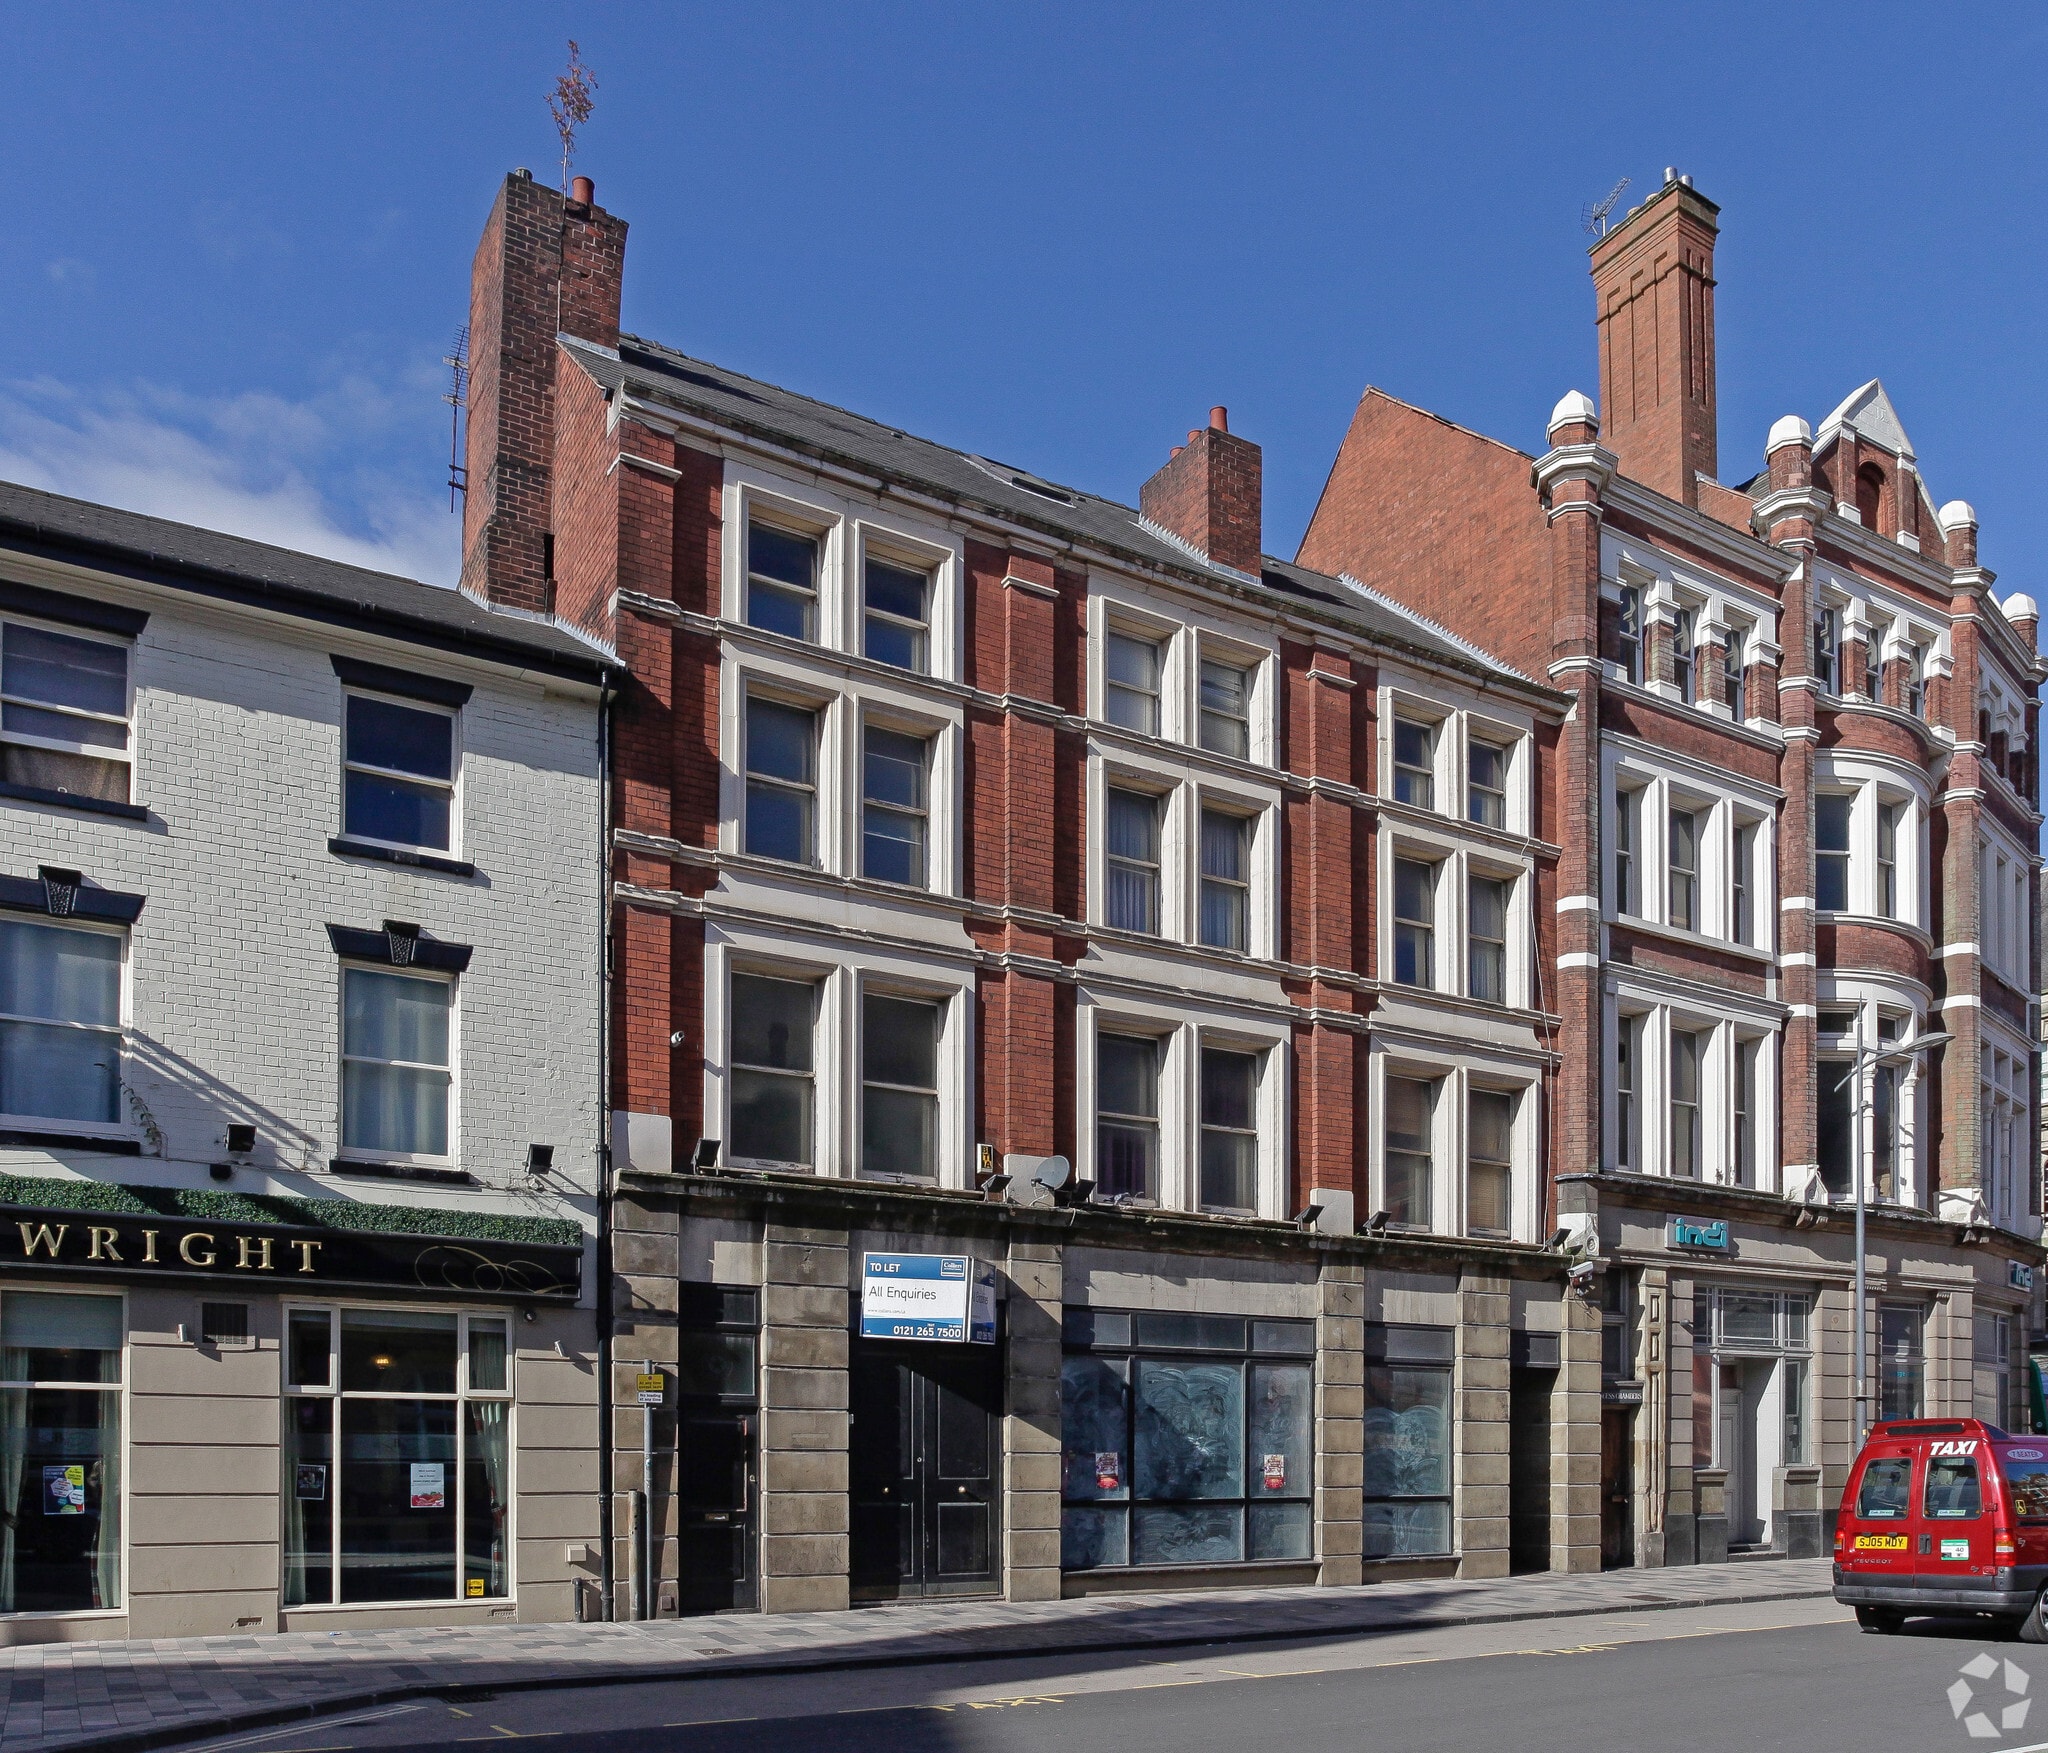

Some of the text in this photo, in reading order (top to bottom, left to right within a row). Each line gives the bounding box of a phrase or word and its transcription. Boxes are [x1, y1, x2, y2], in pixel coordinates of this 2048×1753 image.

[1675, 1217, 1727, 1248] indi
[15, 1221, 323, 1272] WRIGHT
[870, 1262, 901, 1273] TO LET
[869, 1285, 937, 1302] All Enquiries
[893, 1325, 961, 1338] 0121 265 7500
[1930, 1441, 1977, 1456] TAXI
[1859, 1538, 1883, 1547] SJ05
